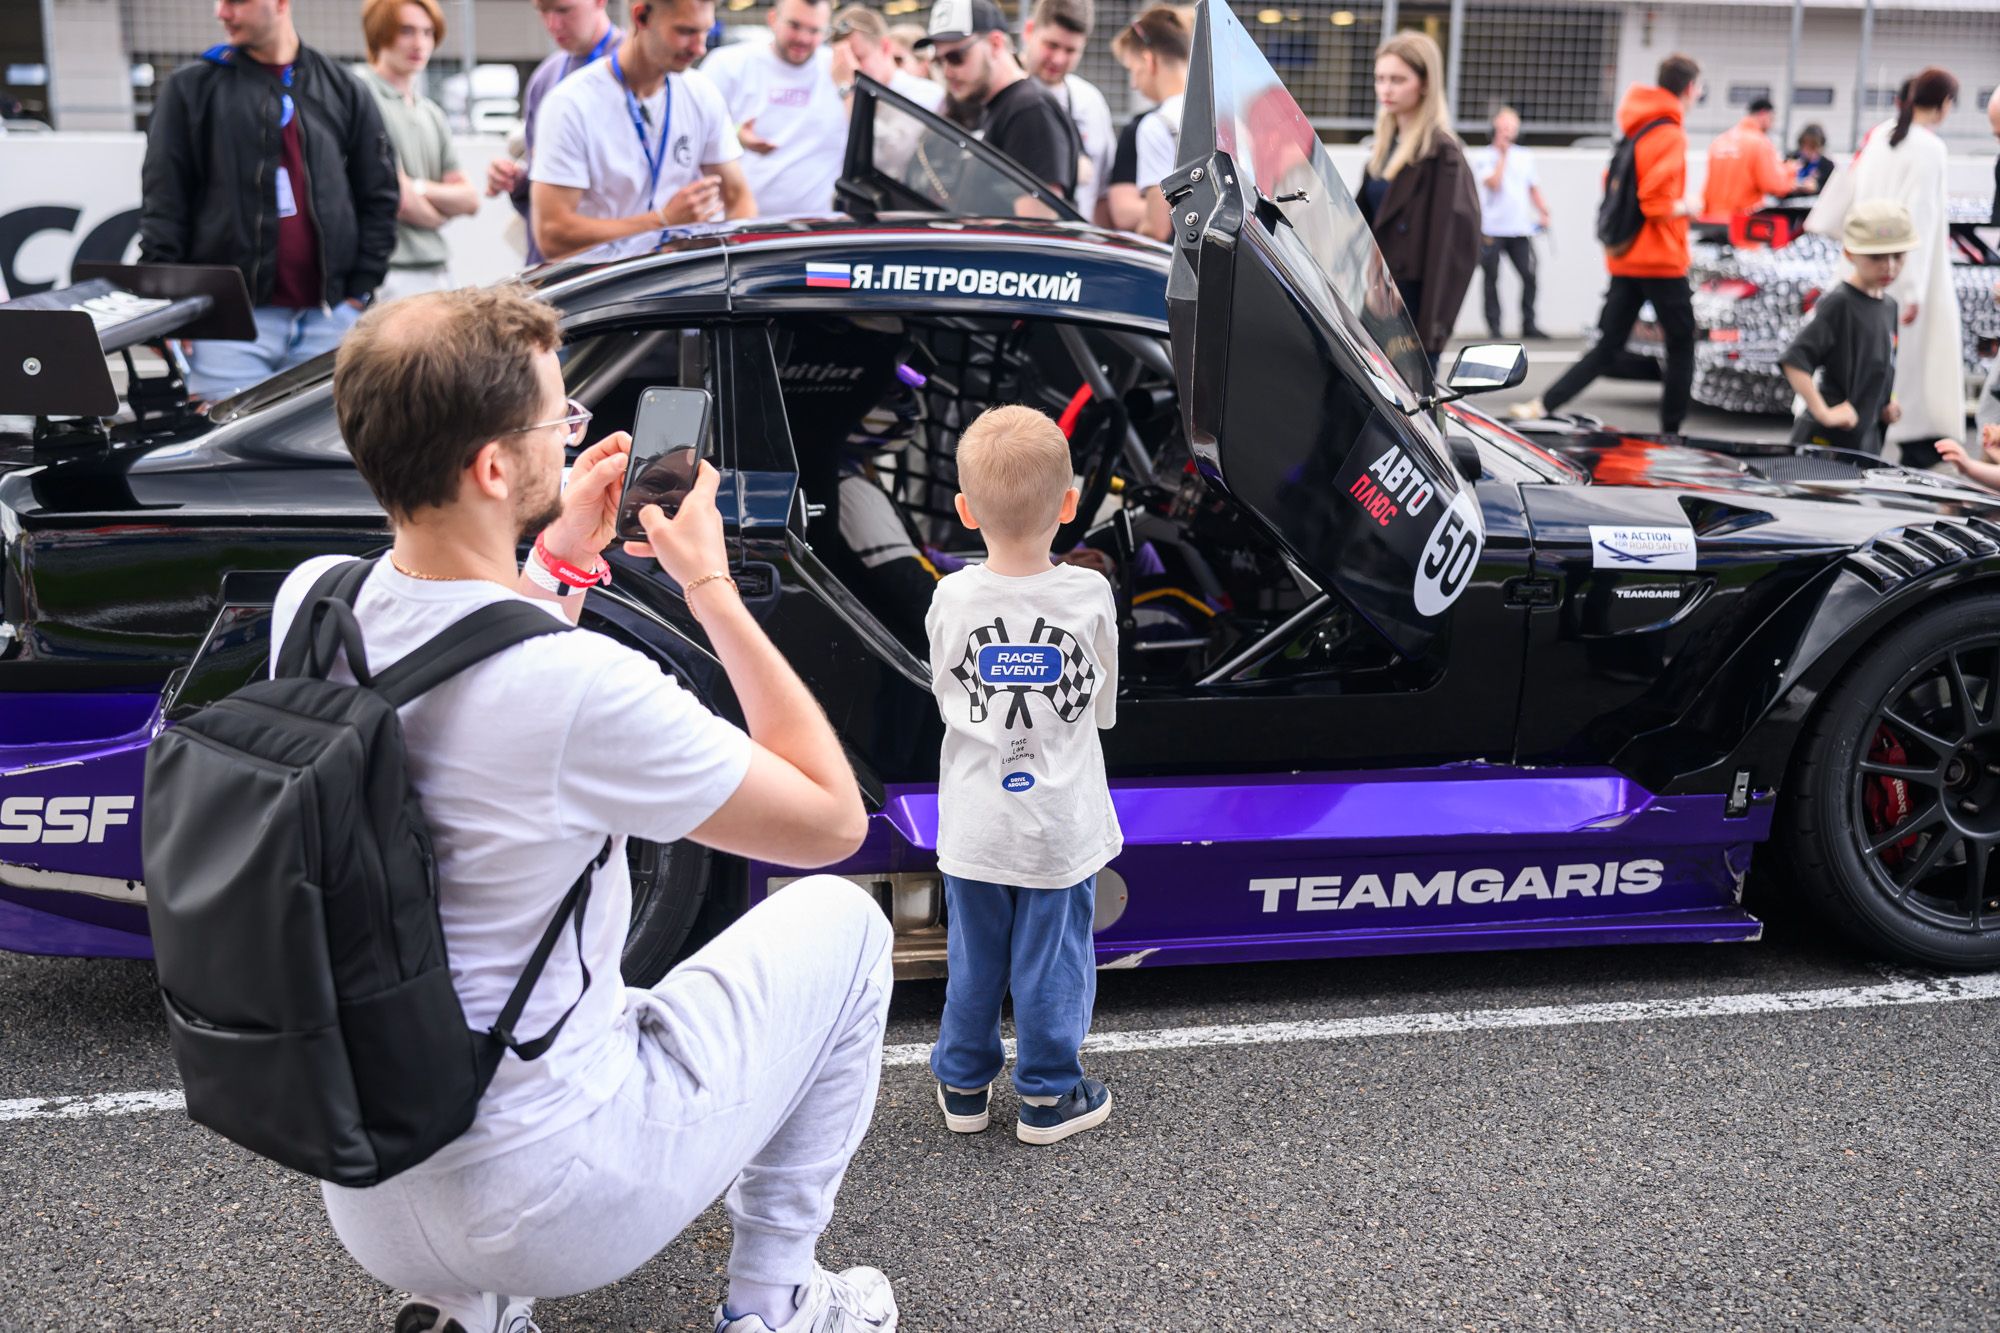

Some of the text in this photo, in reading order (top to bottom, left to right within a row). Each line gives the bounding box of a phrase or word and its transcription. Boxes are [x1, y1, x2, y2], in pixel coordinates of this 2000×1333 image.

[851, 264, 1082, 302] Я.ПЕТРОВСКИЙ
[1368, 444, 1434, 517] АВТО
[1349, 473, 1398, 527] ПЛЮС
[1631, 532, 1671, 541] ACTION
[1629, 542, 1654, 550] ROAD
[1656, 542, 1688, 551] SAFETY
[1424, 510, 1477, 597] 50
[1616, 590, 1680, 599] TEAMGARIS
[997, 652, 1045, 664] RACE
[990, 665, 1049, 676] EVENT
[1010, 738, 1027, 747] Fast
[1248, 858, 1665, 914] TEAMGARIS
